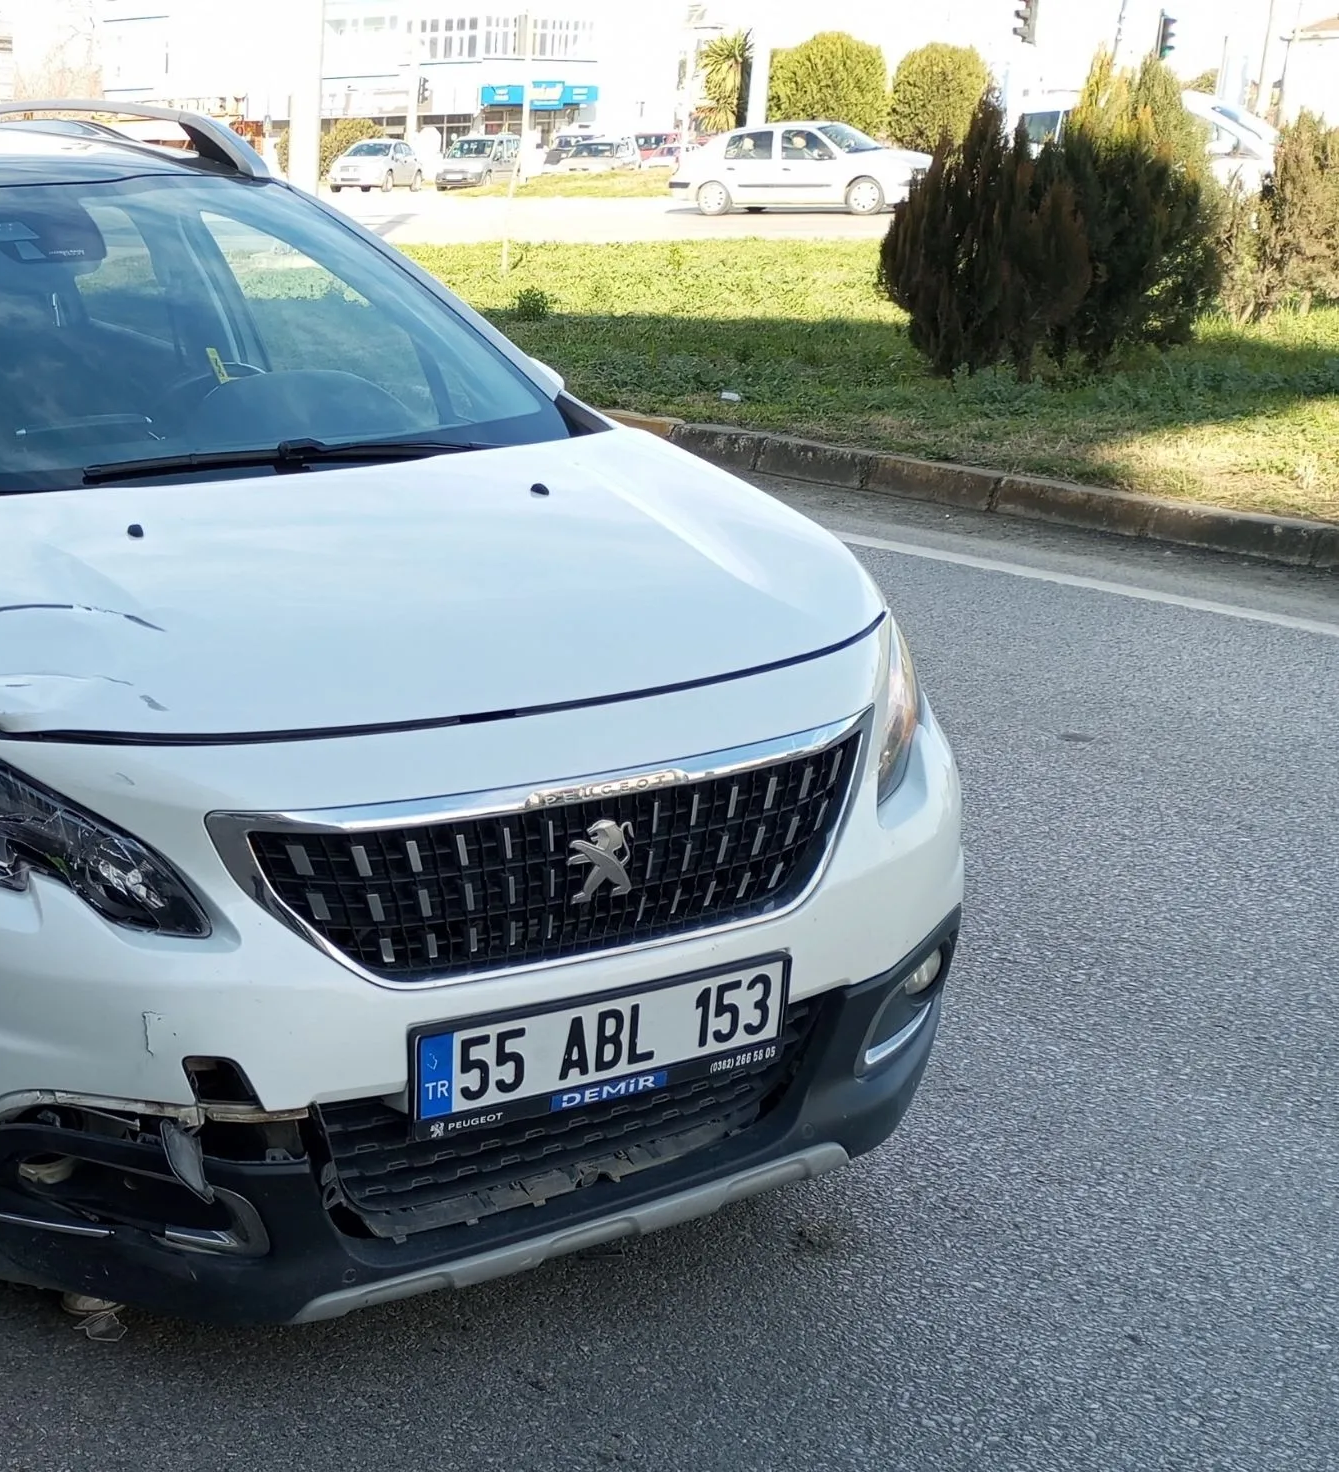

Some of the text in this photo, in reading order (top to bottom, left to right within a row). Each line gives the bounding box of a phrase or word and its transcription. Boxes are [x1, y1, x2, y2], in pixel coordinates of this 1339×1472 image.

[545, 774, 667, 806] PEUGEOT
[460, 973, 772, 1101] 55 ABL 153
[765, 1046, 776, 1059] 05
[425, 1080, 449, 1100] TR
[448, 1112, 504, 1131] PEUGEOT
